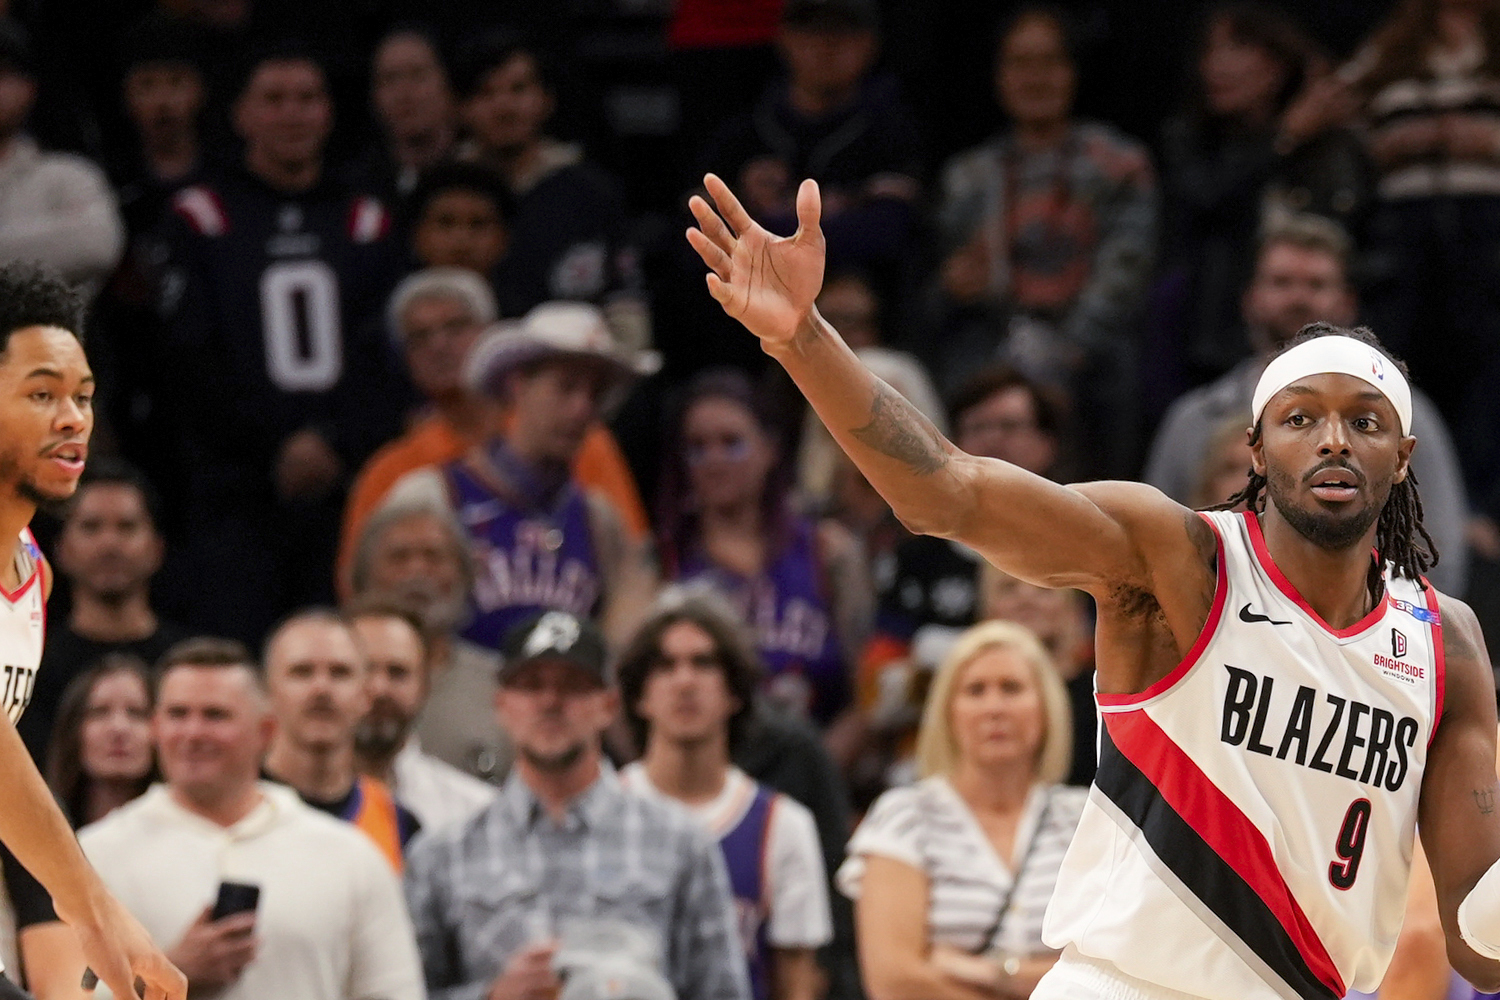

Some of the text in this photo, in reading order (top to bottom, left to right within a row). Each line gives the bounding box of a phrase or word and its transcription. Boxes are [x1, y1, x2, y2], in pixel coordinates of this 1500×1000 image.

[260, 263, 341, 391] 0
[1374, 654, 1425, 679] BRIGHTSIDE
[1383, 670, 1415, 684] WINDOWS
[1221, 664, 1419, 792] BLAZERS
[1328, 798, 1372, 891] 9
